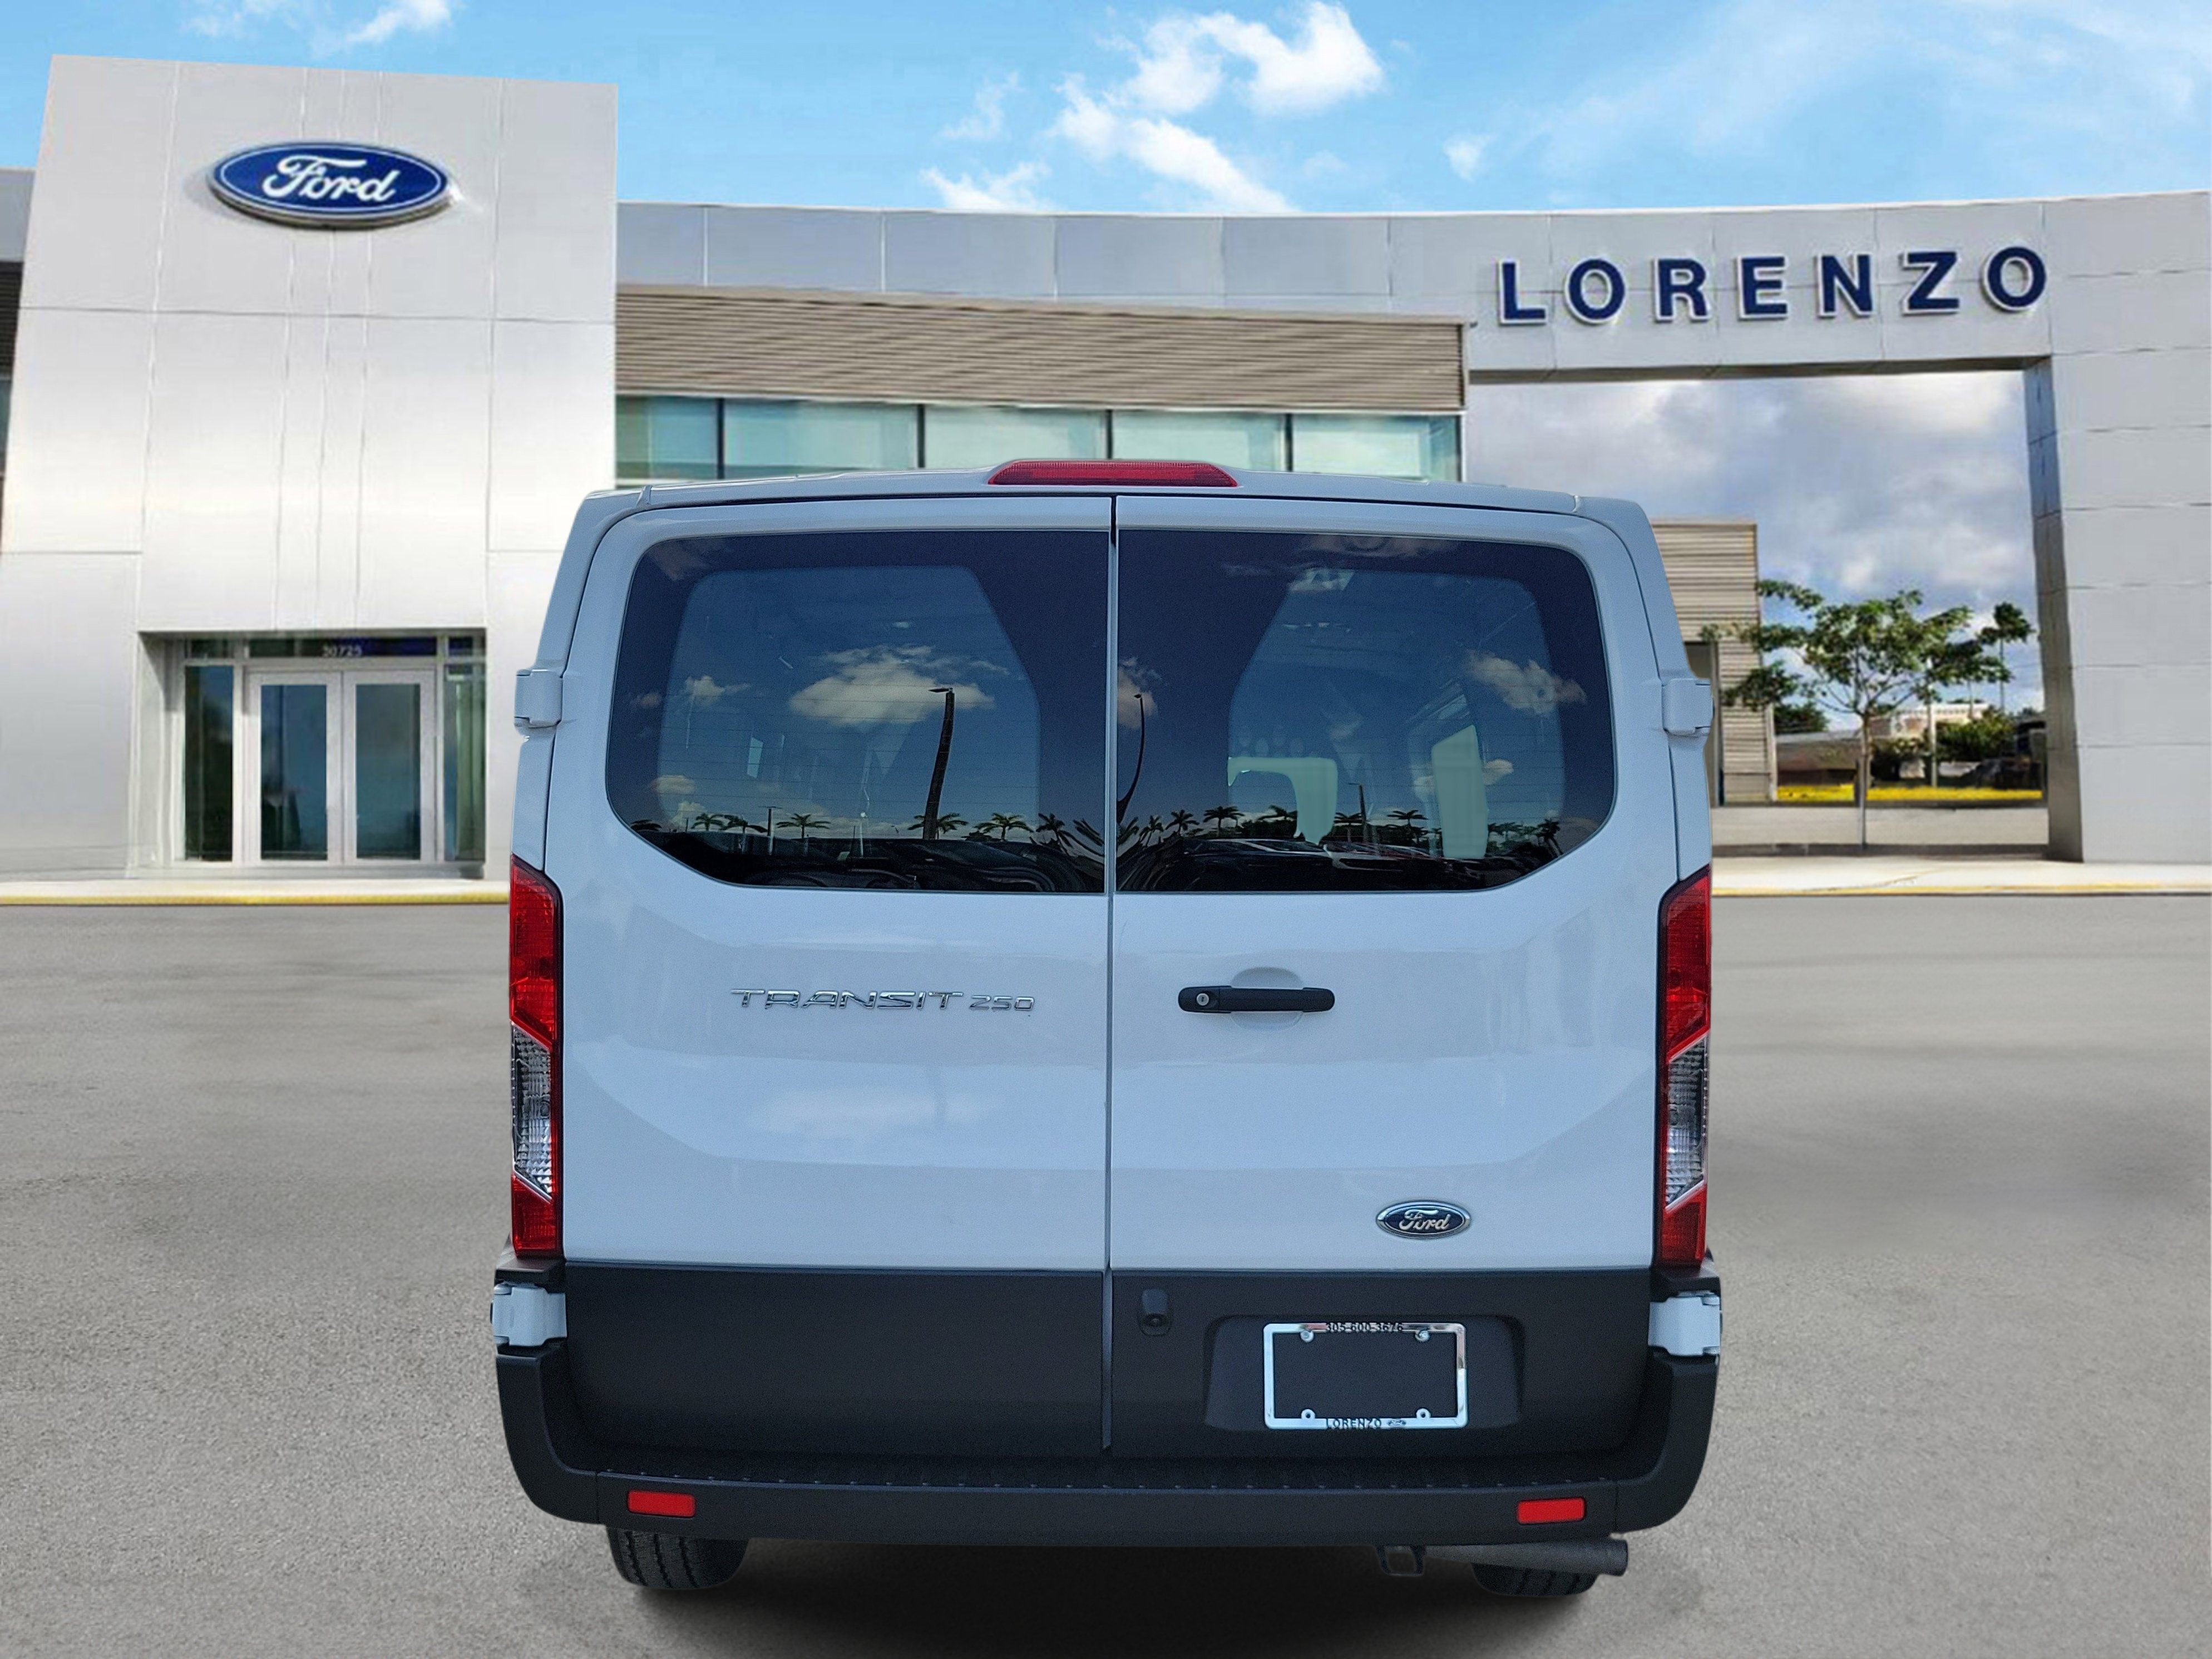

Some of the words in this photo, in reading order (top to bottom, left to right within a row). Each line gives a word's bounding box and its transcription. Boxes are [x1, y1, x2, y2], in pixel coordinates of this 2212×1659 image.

[262, 154, 401, 202] Ford
[1498, 246, 2047, 326] LORENZO
[730, 989, 964, 1010] TRANSIT
[969, 994, 1035, 1011] 250
[1398, 1209, 1451, 1231] Ford
[1325, 1417, 1382, 1430] LORENZO
